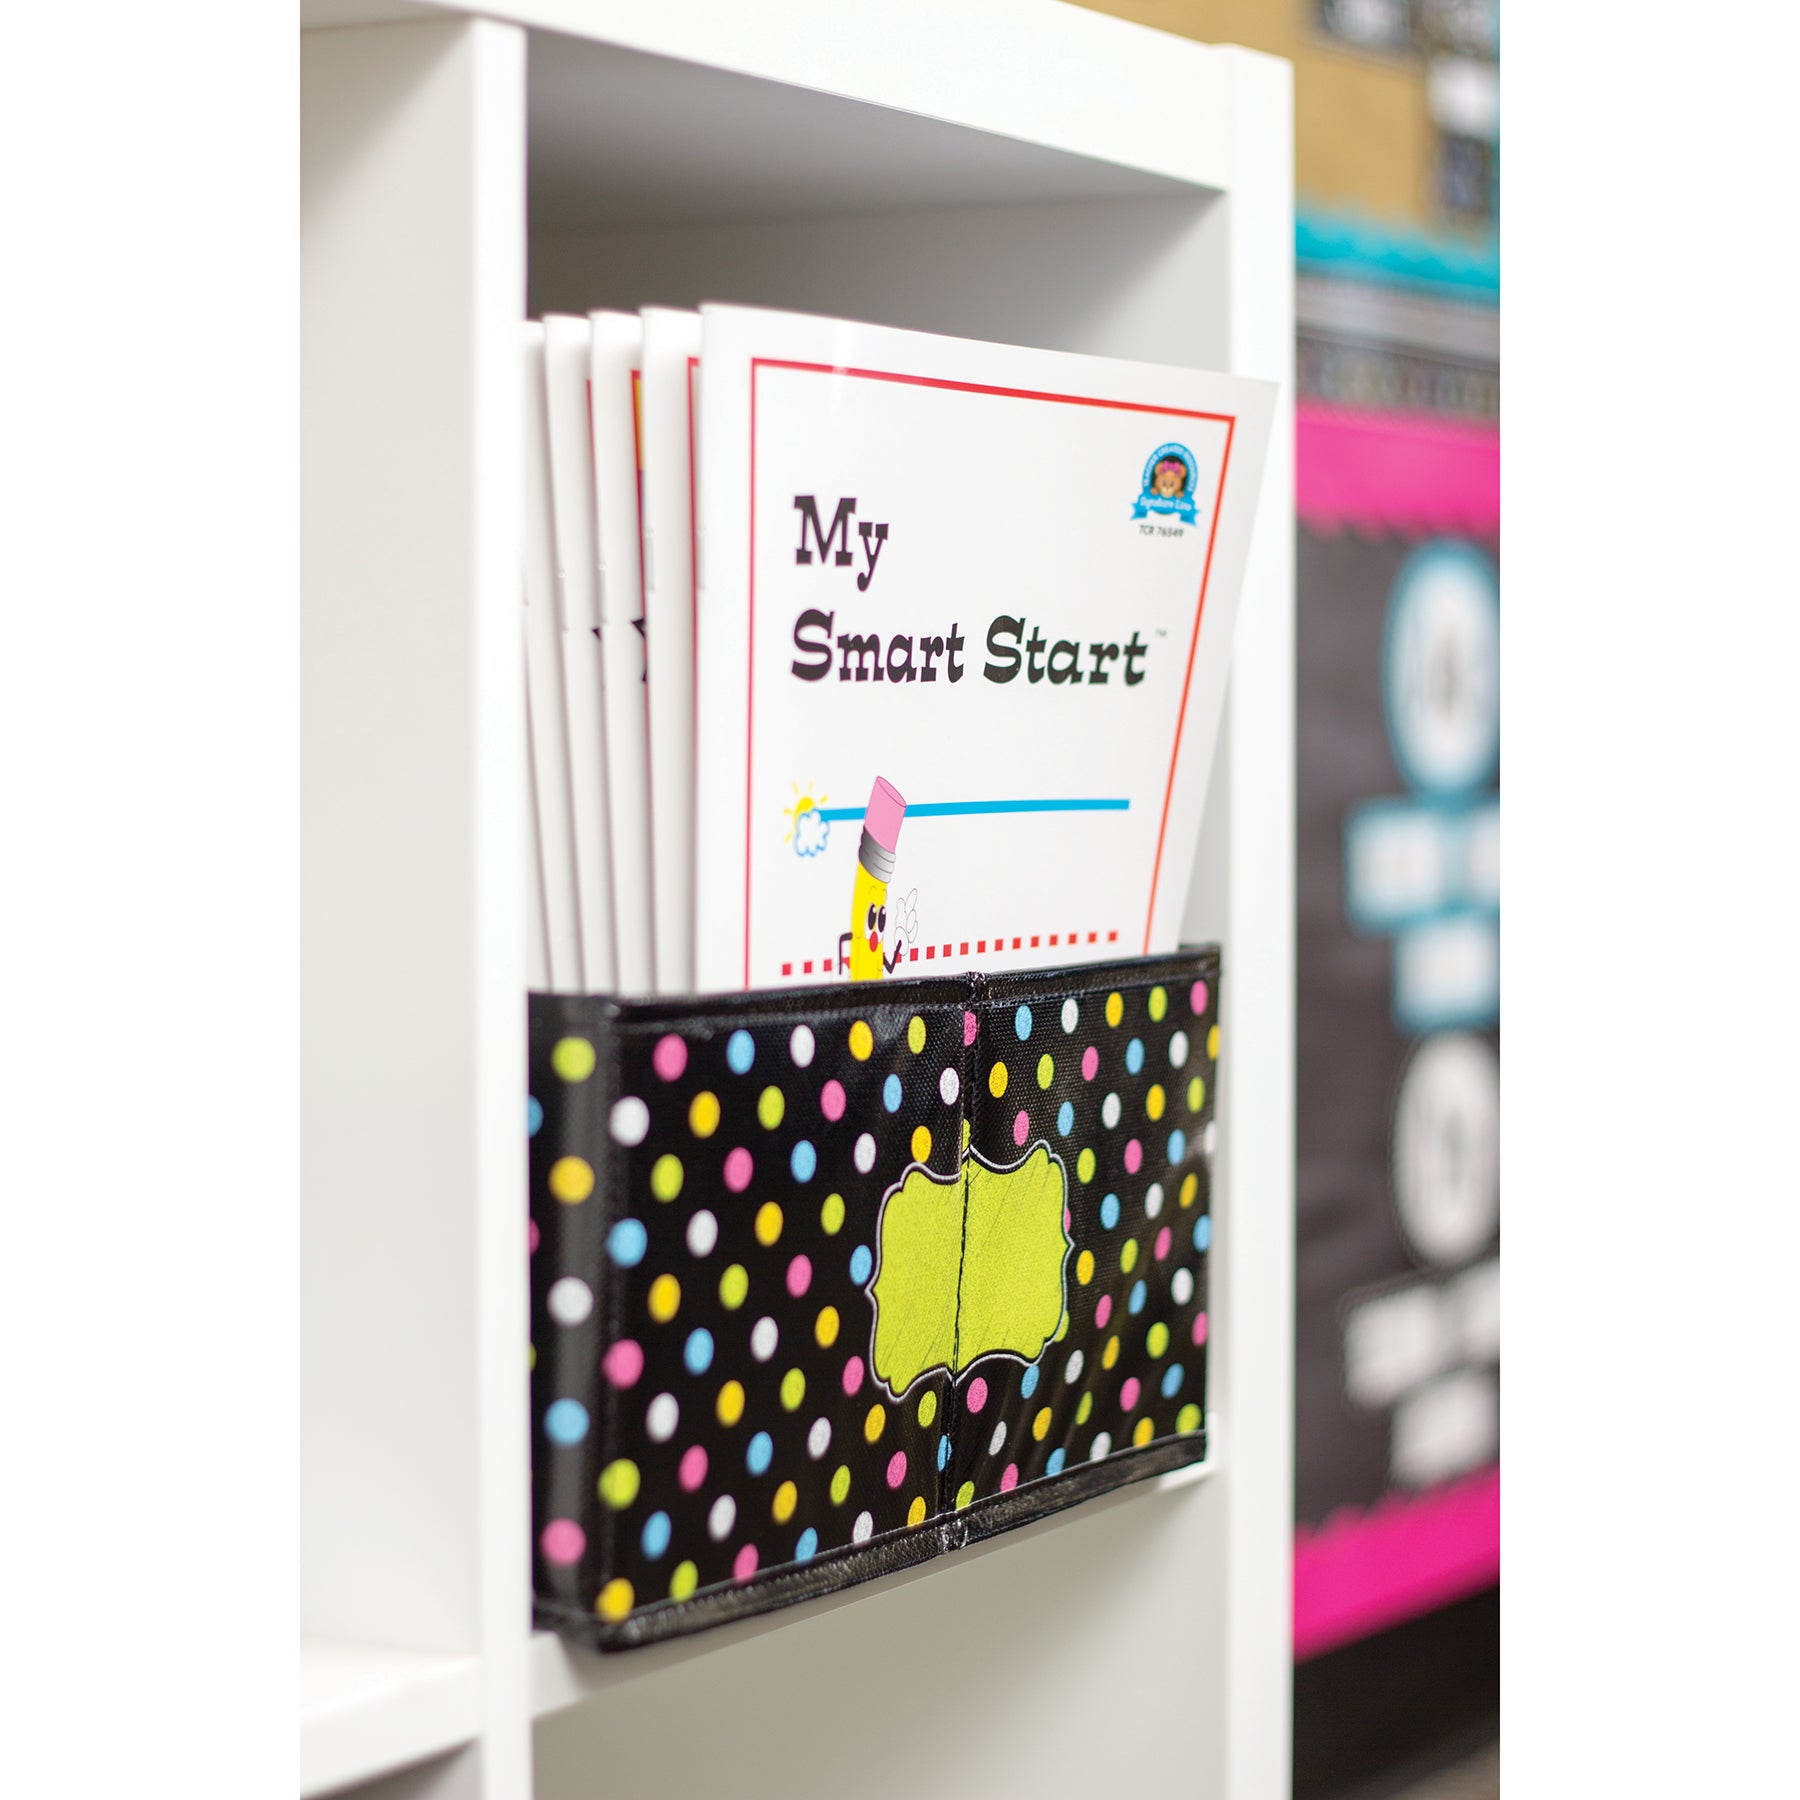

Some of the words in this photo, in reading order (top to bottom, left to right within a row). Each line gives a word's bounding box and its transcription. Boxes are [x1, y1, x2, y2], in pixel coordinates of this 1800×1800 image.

[793, 494, 890, 593] My
[1139, 525, 1155, 536] TCR
[790, 608, 966, 684] Smart
[982, 614, 1149, 688] Start
